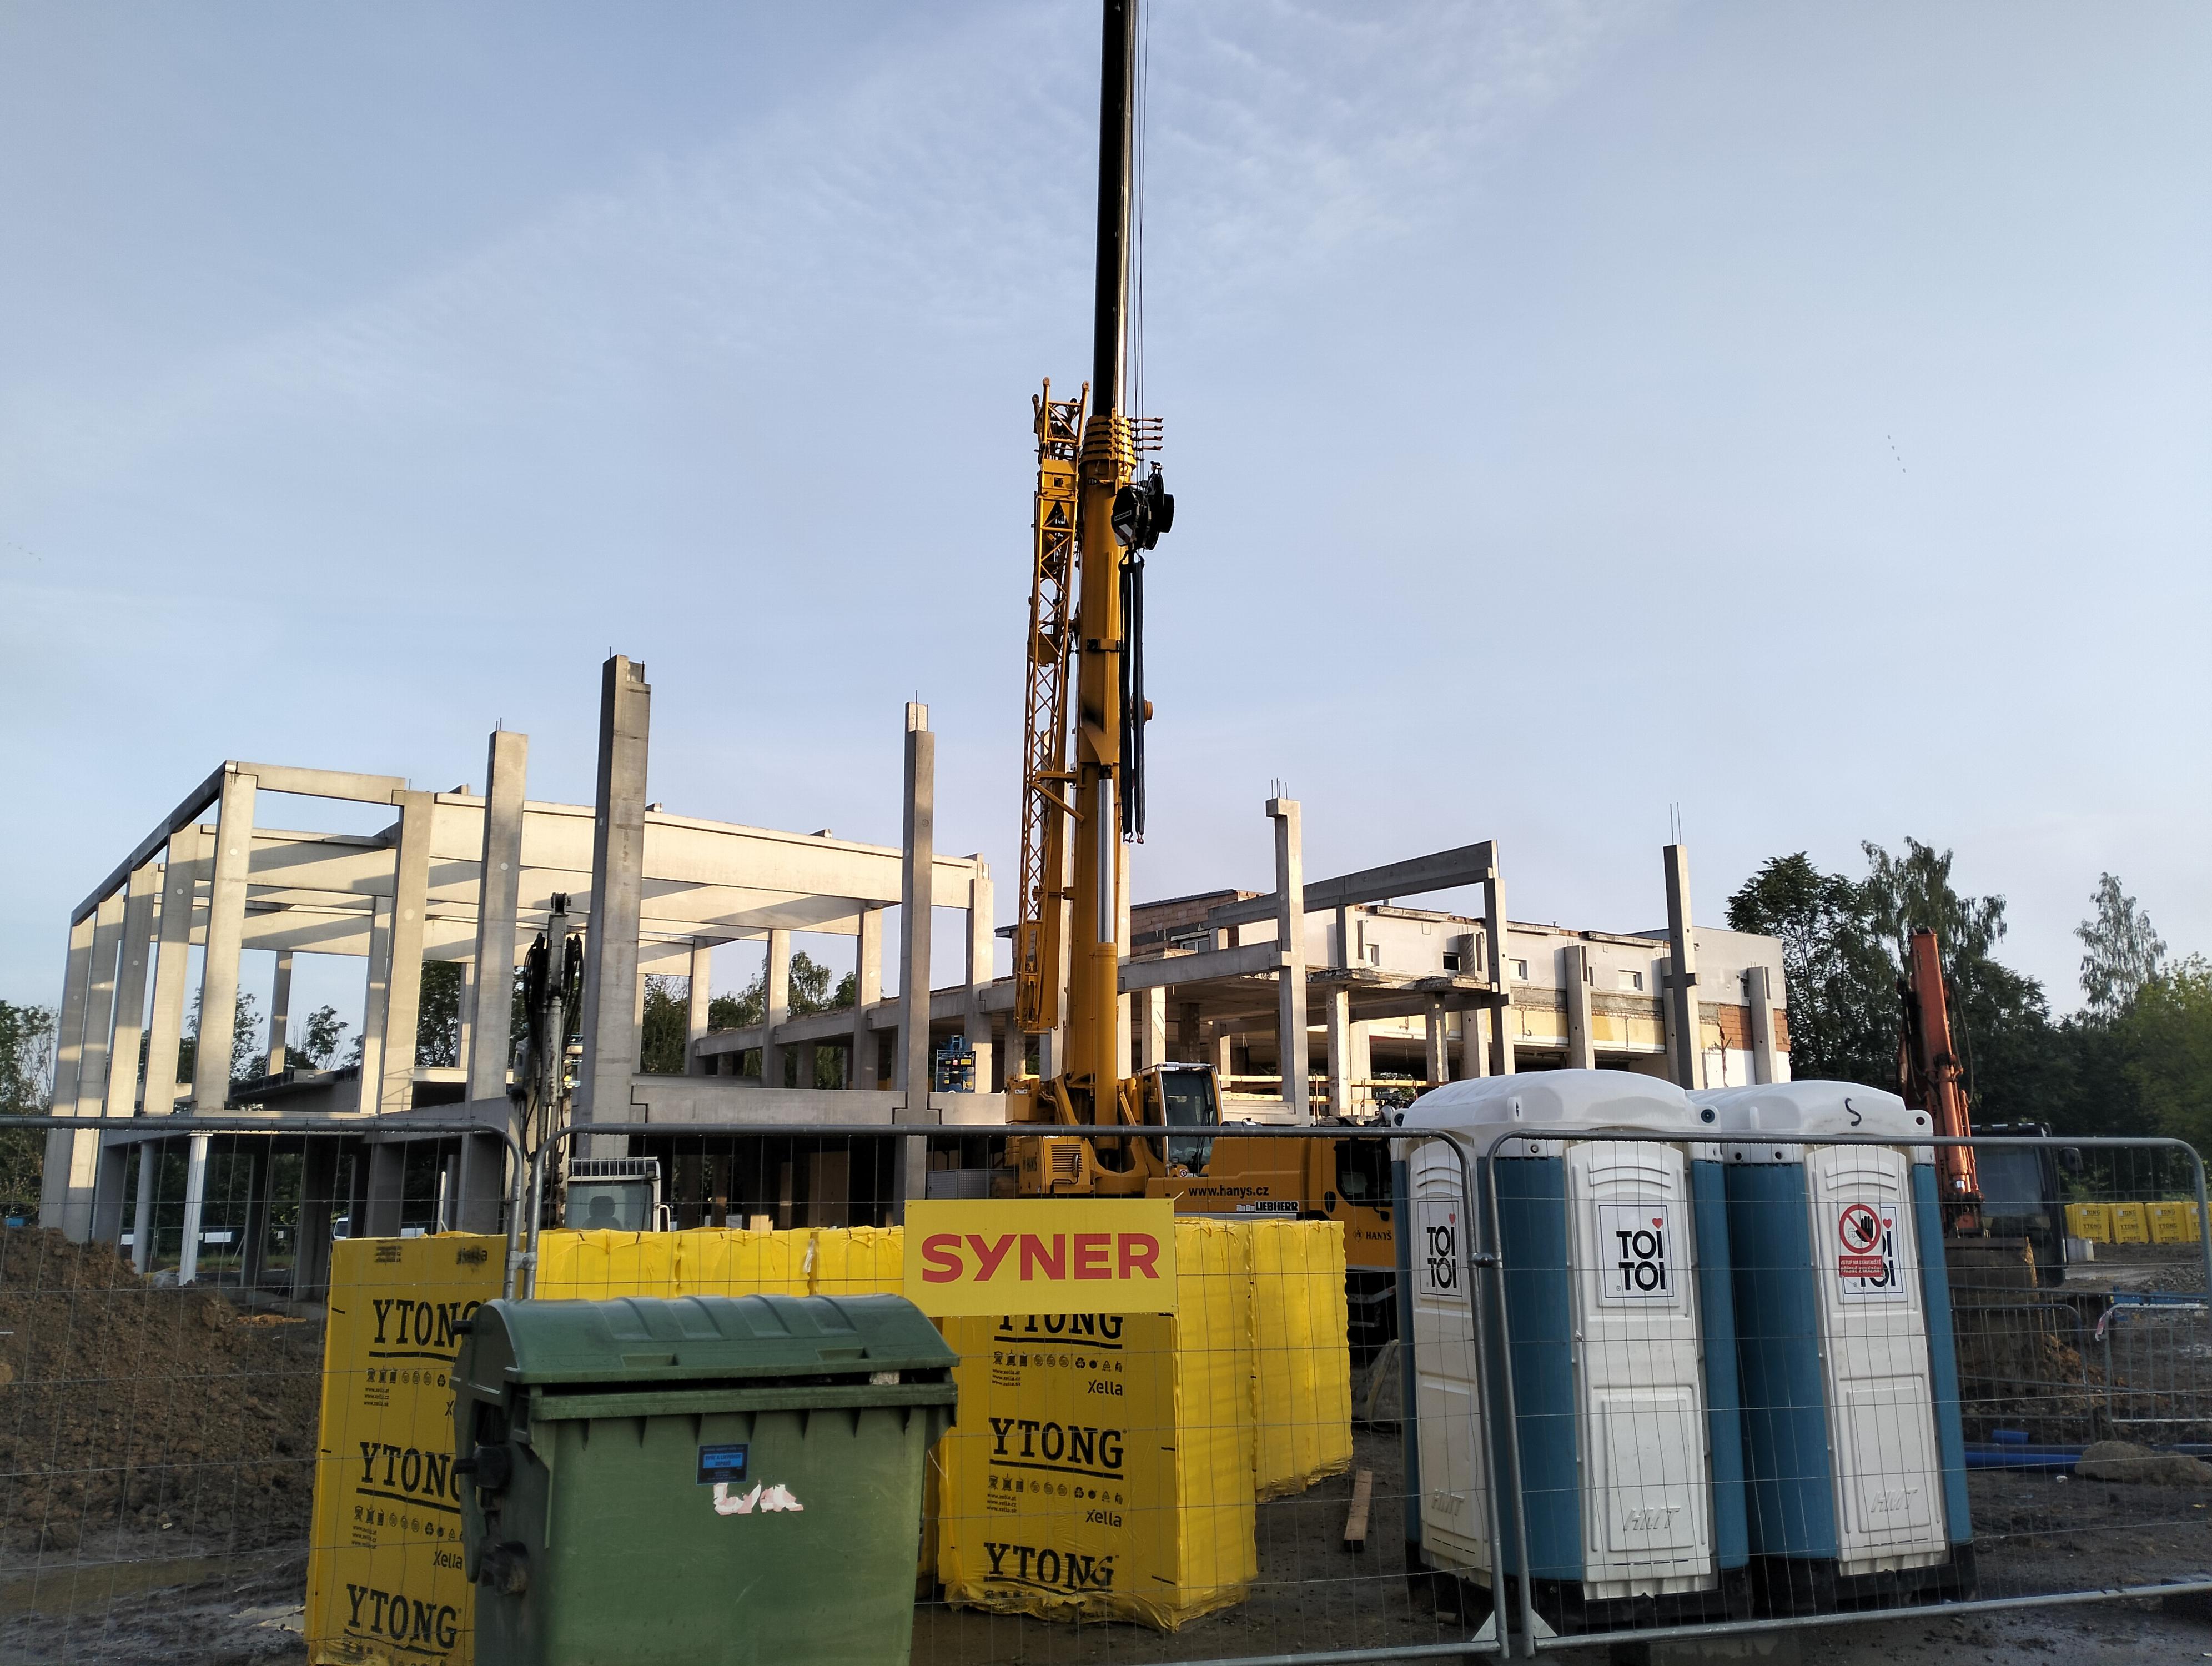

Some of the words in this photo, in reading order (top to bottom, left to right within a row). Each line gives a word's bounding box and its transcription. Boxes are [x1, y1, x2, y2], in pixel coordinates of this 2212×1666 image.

[1189, 1185, 1269, 1199] www.hanys.cz
[1255, 1202, 1298, 1211] LIEBHERR
[1426, 1226, 1456, 1257] TOI
[1616, 1230, 1663, 1259] TOI
[922, 1233, 1160, 1283] SYNER
[1427, 1257, 1457, 1288] TOI
[1618, 1261, 1666, 1291] TOI
[988, 1417, 1124, 1469] YTONG
[983, 1542, 1114, 1590] YTONG
[346, 1583, 458, 1649] YTONG
